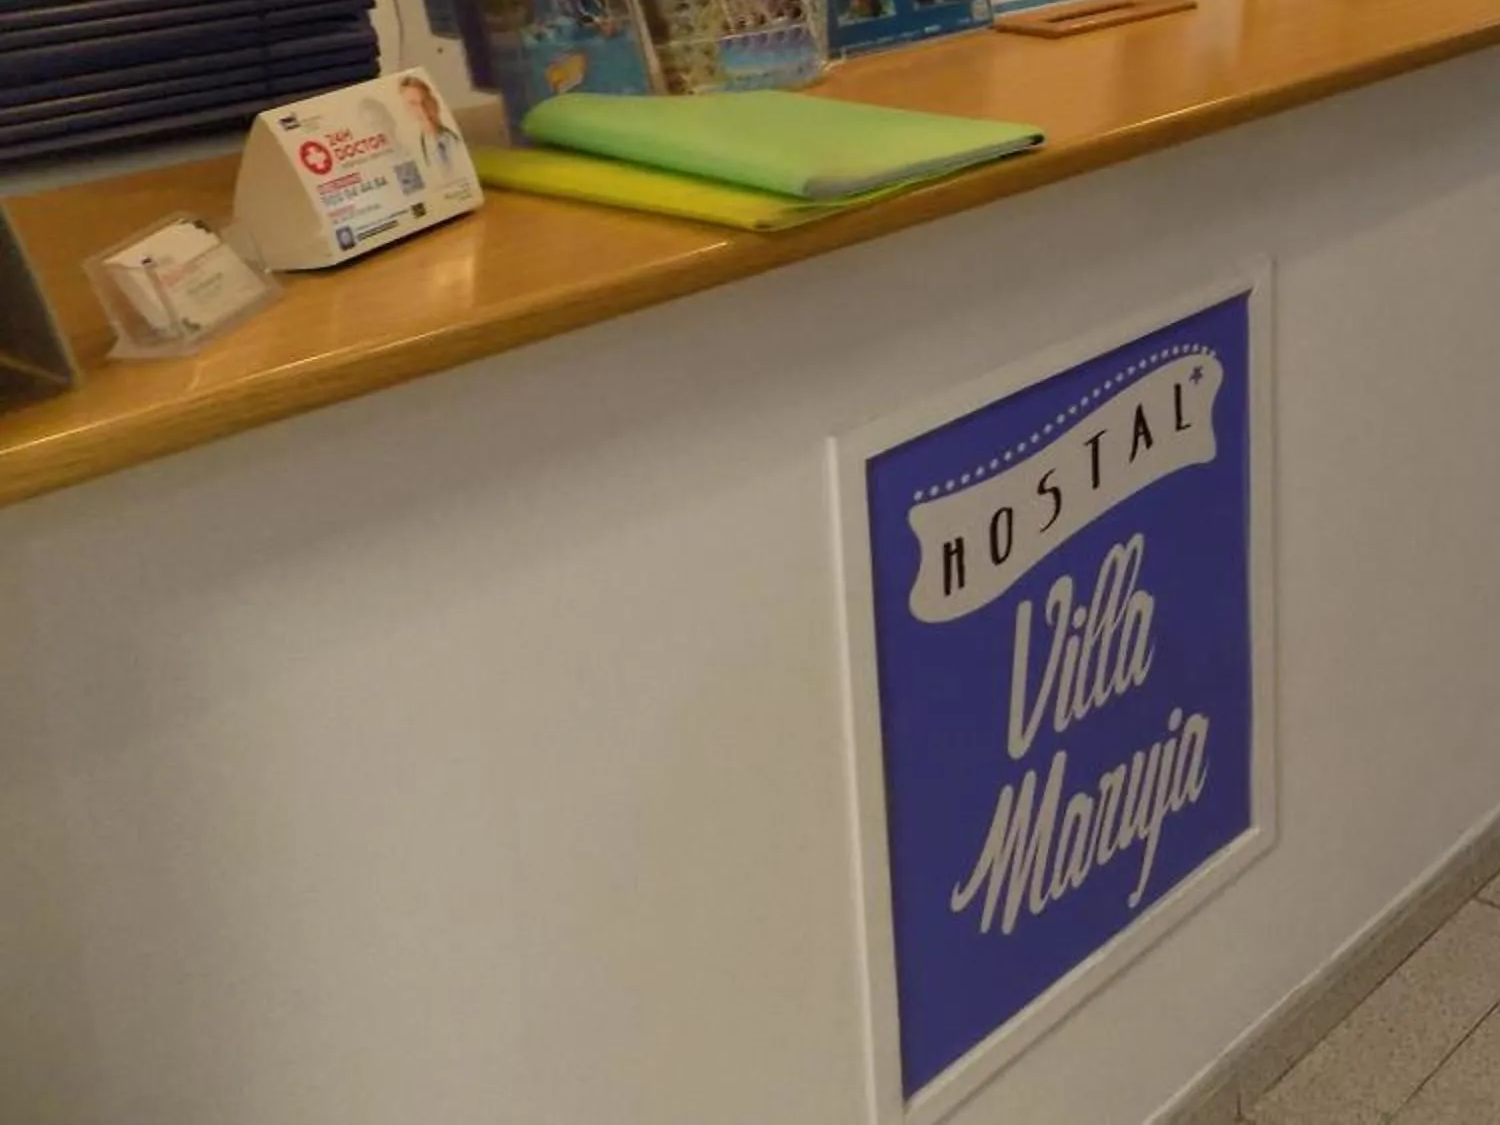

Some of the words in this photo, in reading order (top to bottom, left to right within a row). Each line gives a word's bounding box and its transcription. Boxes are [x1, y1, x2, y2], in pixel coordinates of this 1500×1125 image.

[333, 132, 389, 161] DOCTOR
[941, 382, 1193, 597] HOSTAL
[1006, 532, 1156, 759] Villa
[950, 706, 1210, 937] Maruja
